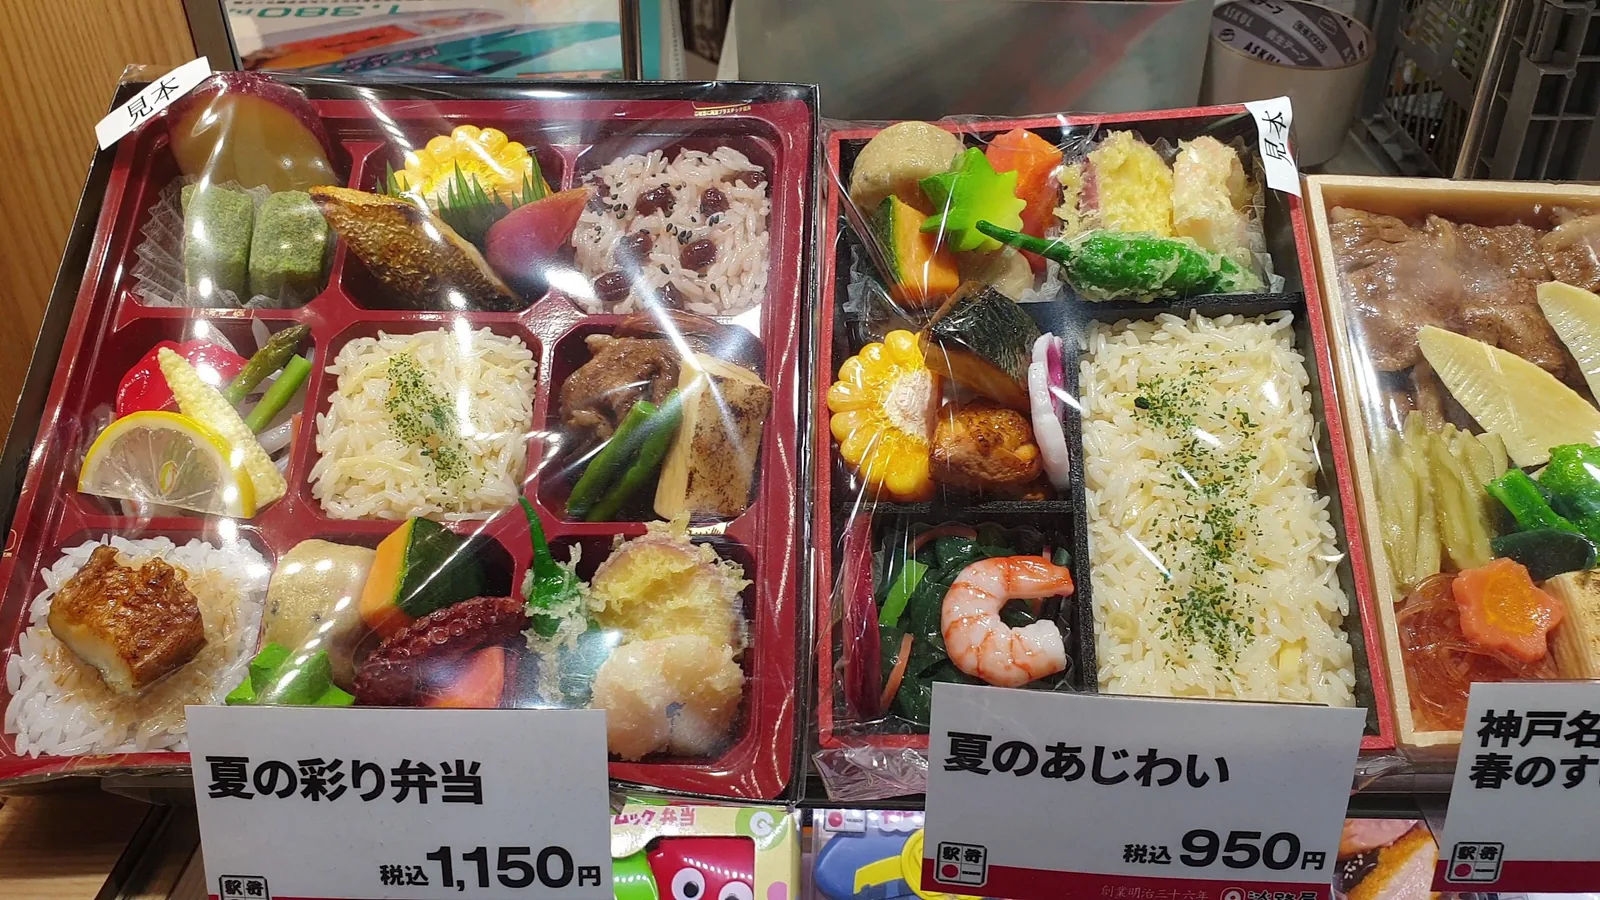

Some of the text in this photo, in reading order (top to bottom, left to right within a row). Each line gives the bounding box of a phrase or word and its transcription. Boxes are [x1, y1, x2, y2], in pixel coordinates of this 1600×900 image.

[1243, 41, 1281, 63] ASKU
[128, 77, 180, 128] 見本
[1261, 110, 1293, 167] 見本
[205, 755, 484, 805] 夏の彩り弁当
[944, 731, 1230, 788] 夏のあじわい
[1468, 752, 1600, 790] 春のす
